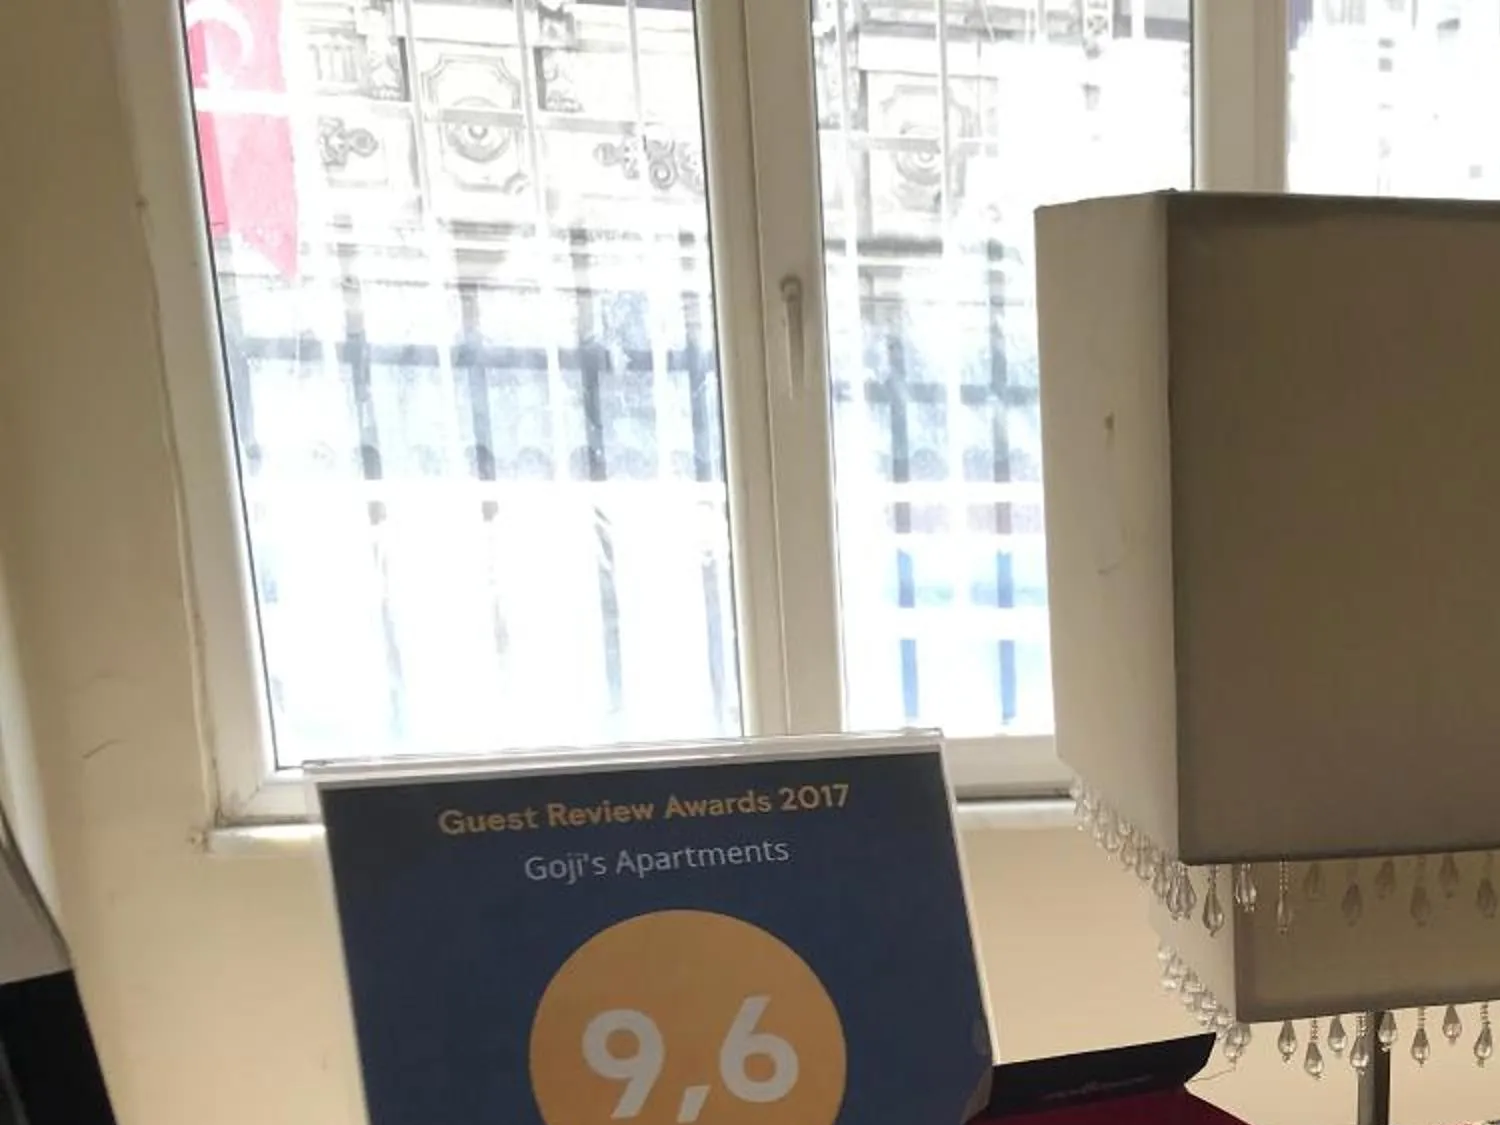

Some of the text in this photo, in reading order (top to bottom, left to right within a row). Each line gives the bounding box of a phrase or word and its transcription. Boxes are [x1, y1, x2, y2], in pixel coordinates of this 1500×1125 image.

[437, 783, 850, 835] Guest Review Awards 2017
[523, 840, 790, 884] Goji's Apartments
[581, 995, 799, 1124] 9,6
